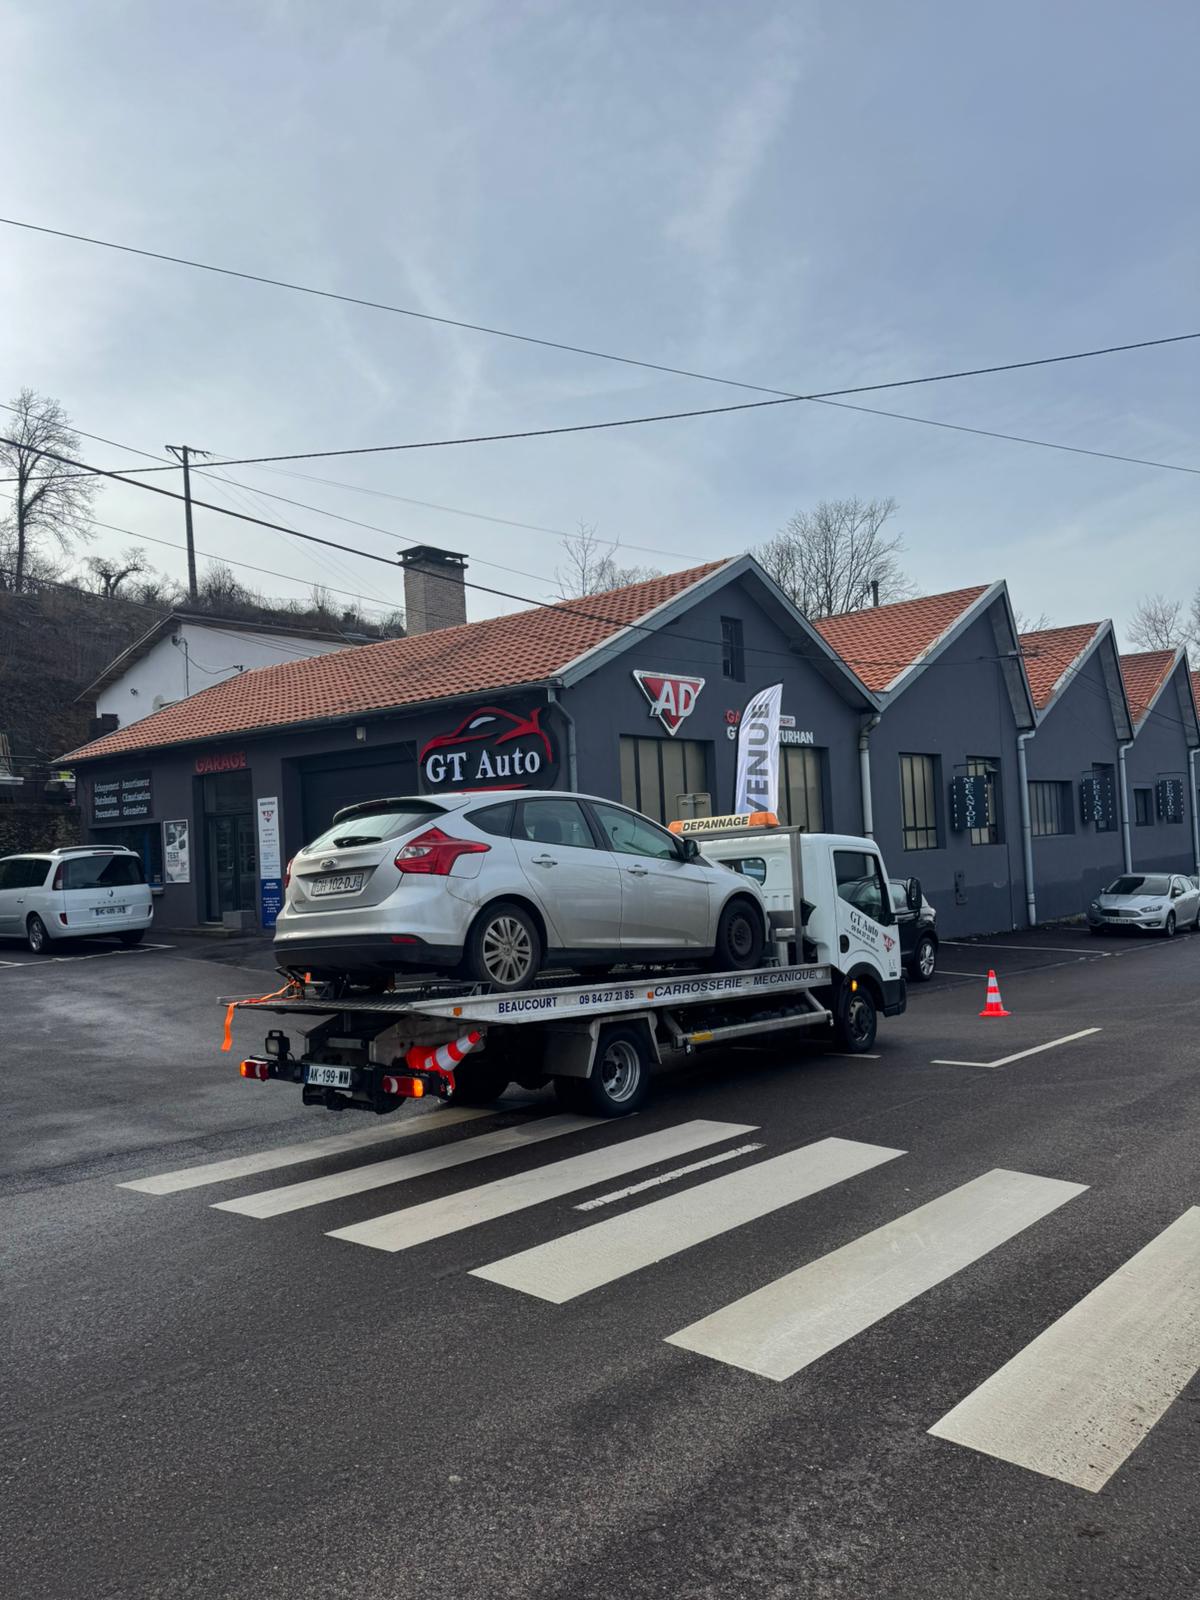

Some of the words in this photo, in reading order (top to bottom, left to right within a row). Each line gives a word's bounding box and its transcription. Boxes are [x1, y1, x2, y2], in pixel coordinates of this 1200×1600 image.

[653, 681, 696, 718] AD
[195, 752, 248, 773] GARAGE
[426, 752, 467, 783] GT
[475, 747, 541, 779] Auto
[682, 816, 750, 832] DEPANNAGE
[850, 911, 861, 926] GT
[863, 920, 879, 938] Auto
[654, 977, 742, 997] CARROSSERIE
[753, 969, 816, 986] MECANIQUE
[498, 997, 558, 1013] BEAUCOURT
[579, 995, 590, 1005] 09
[592, 993, 602, 1004] 84
[604, 992, 613, 1002] 27
[615, 991, 623, 1001] 21
[624, 989, 635, 1000] 85
